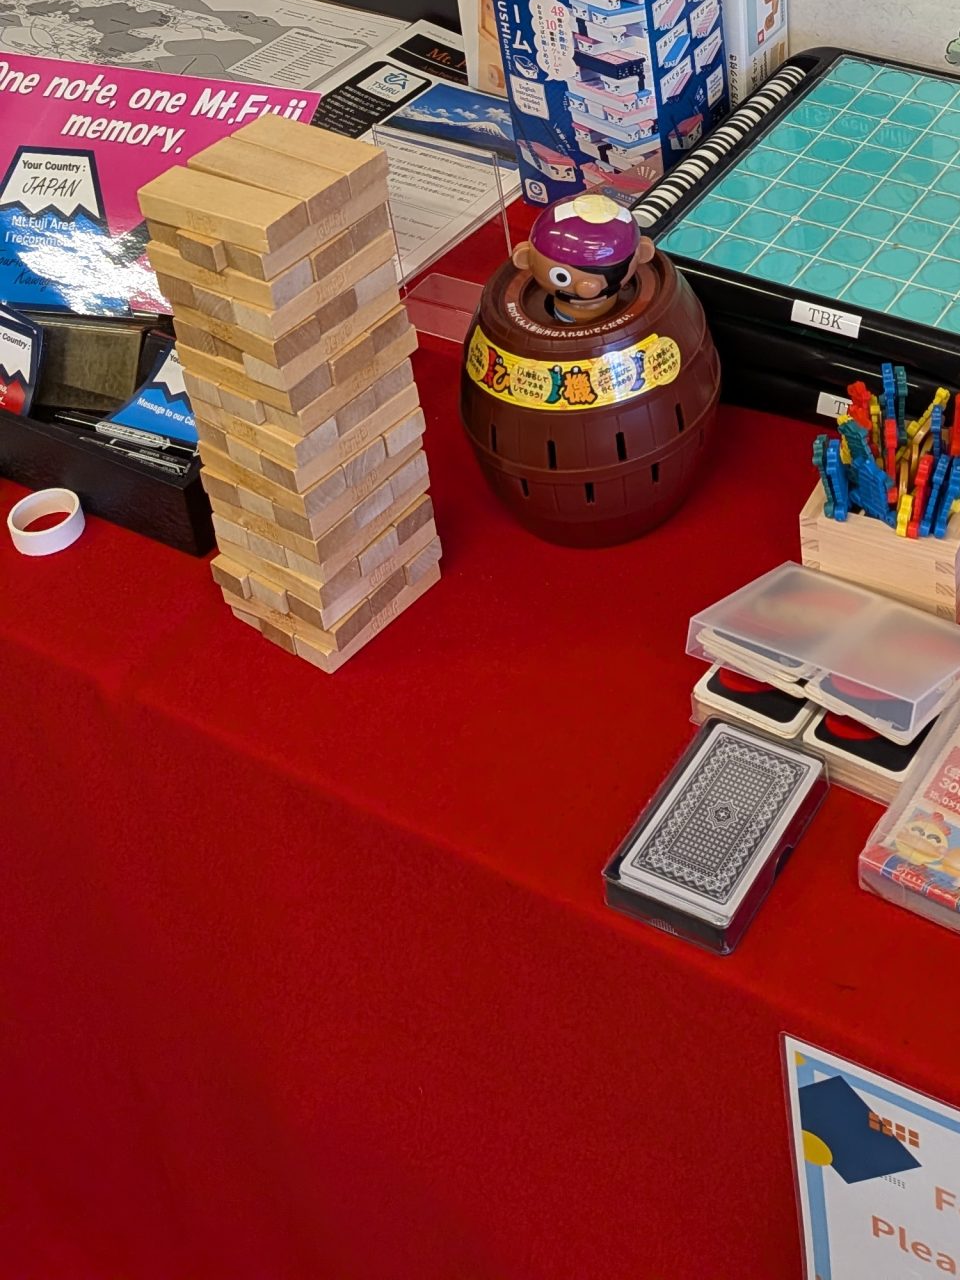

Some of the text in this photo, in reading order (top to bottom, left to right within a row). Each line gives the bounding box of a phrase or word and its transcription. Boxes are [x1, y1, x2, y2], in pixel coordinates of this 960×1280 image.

[44, 74, 117, 108] note,
[129, 87, 187, 114] one
[372, 81, 400, 95] TSURU
[61, 114, 187, 154] memory.
[22, 160, 42, 170] Your
[45, 162, 81, 173] Country
[22, 176, 82, 197] JAPAN
[809, 307, 844, 330] TBK
[137, 398, 185, 424] Message to our
